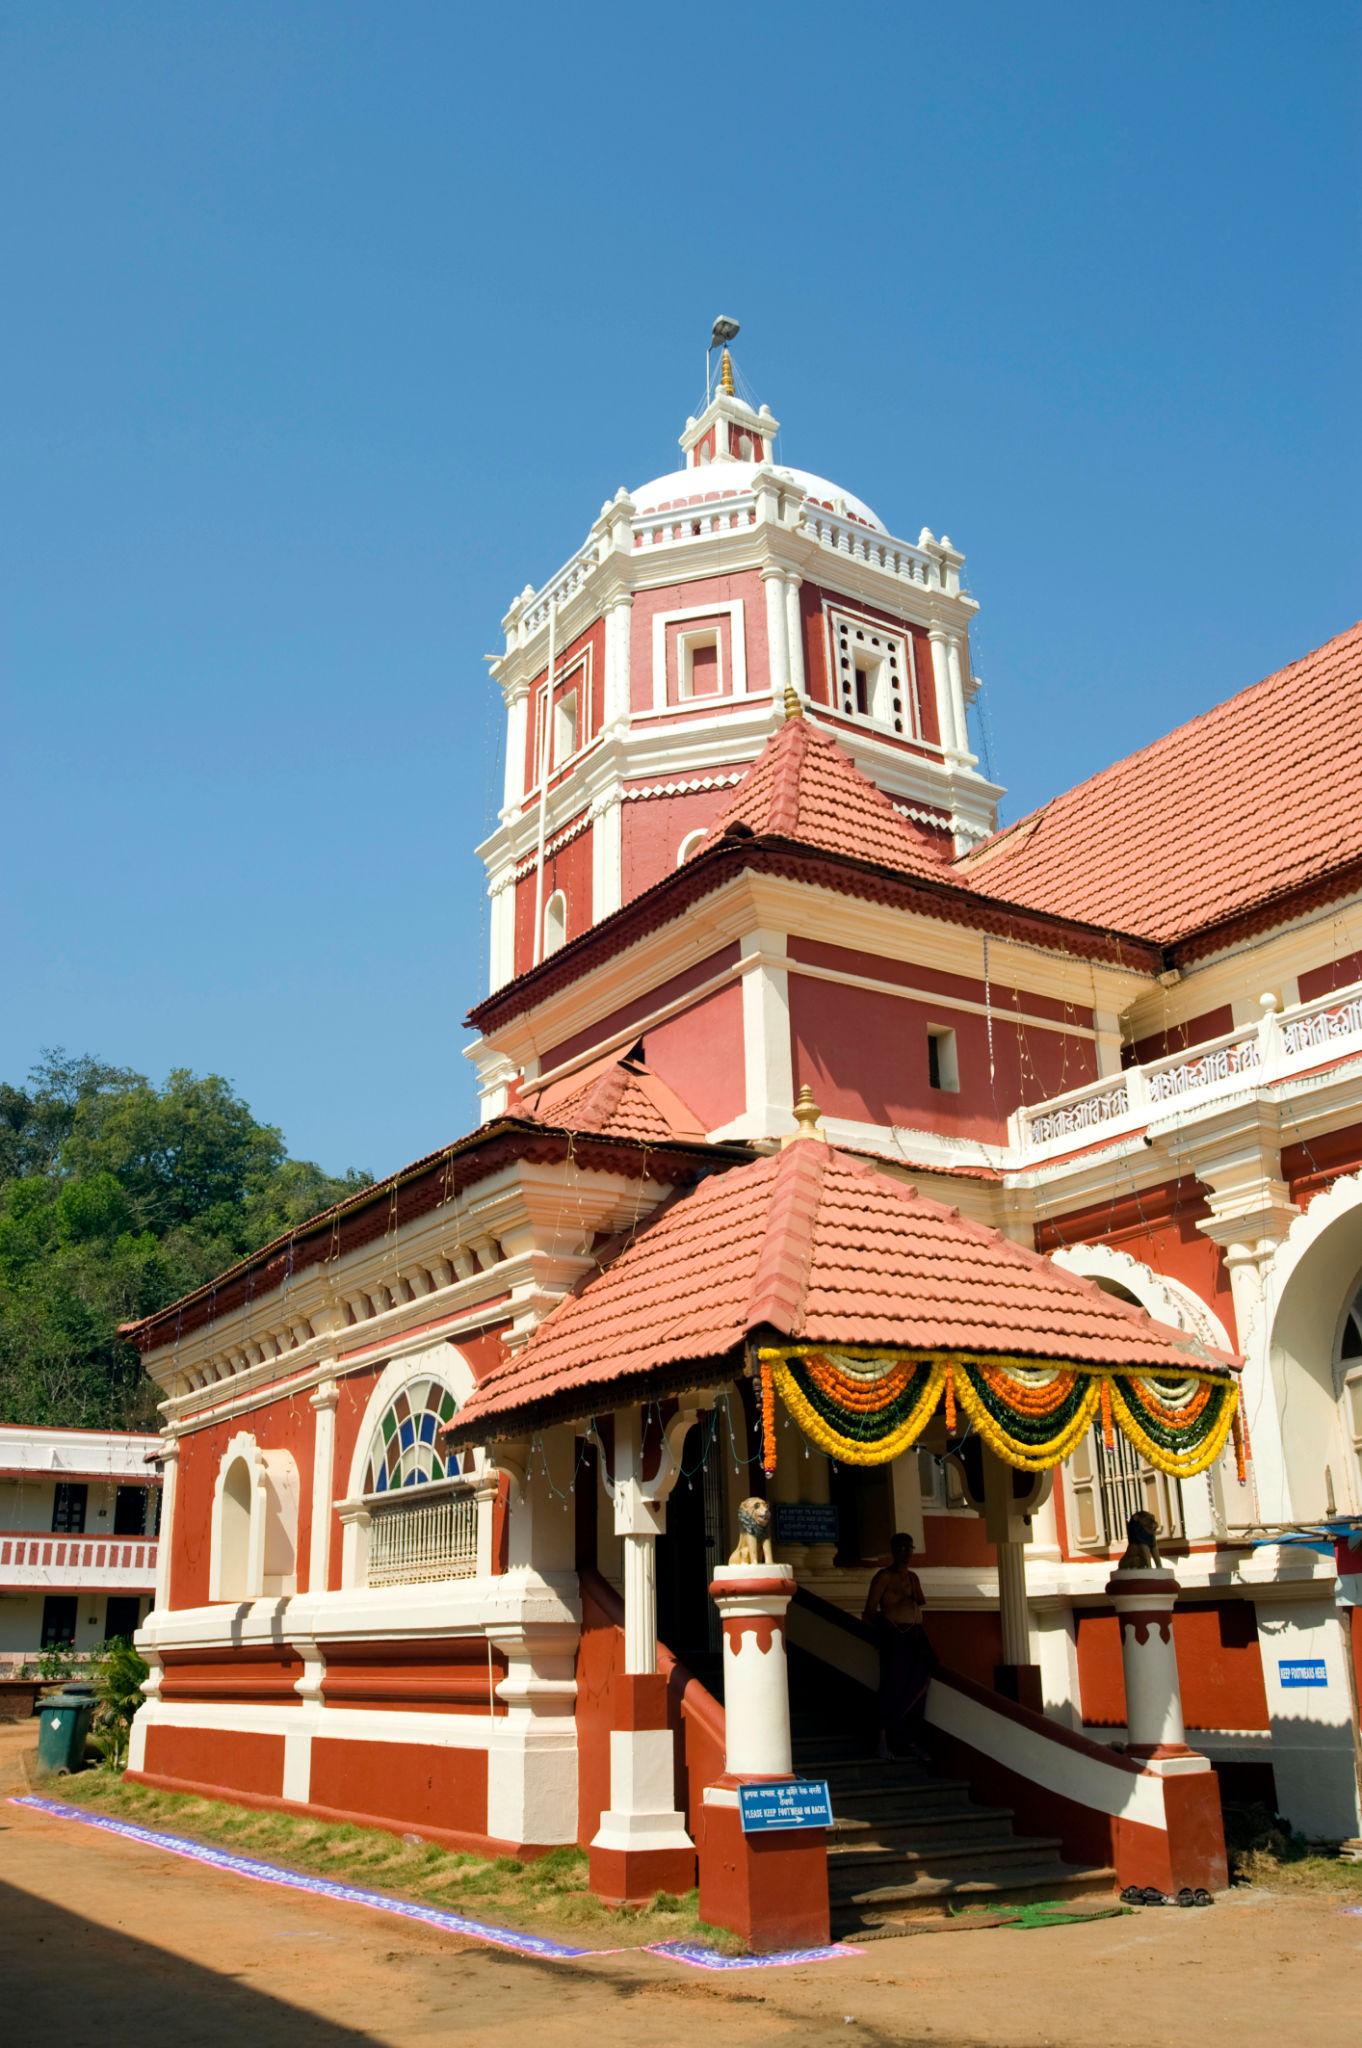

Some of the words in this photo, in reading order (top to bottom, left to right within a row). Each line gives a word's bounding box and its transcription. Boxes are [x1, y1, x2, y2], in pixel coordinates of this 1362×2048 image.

[1280, 1667, 1290, 1680] KEEP
[1315, 1666, 1327, 1680] HERE
[744, 1808, 763, 1819] PLEASE
[764, 1807, 777, 1818] KEEP
[778, 1806, 804, 1817] FOOTWEAR
[804, 1806, 811, 1815] ON
